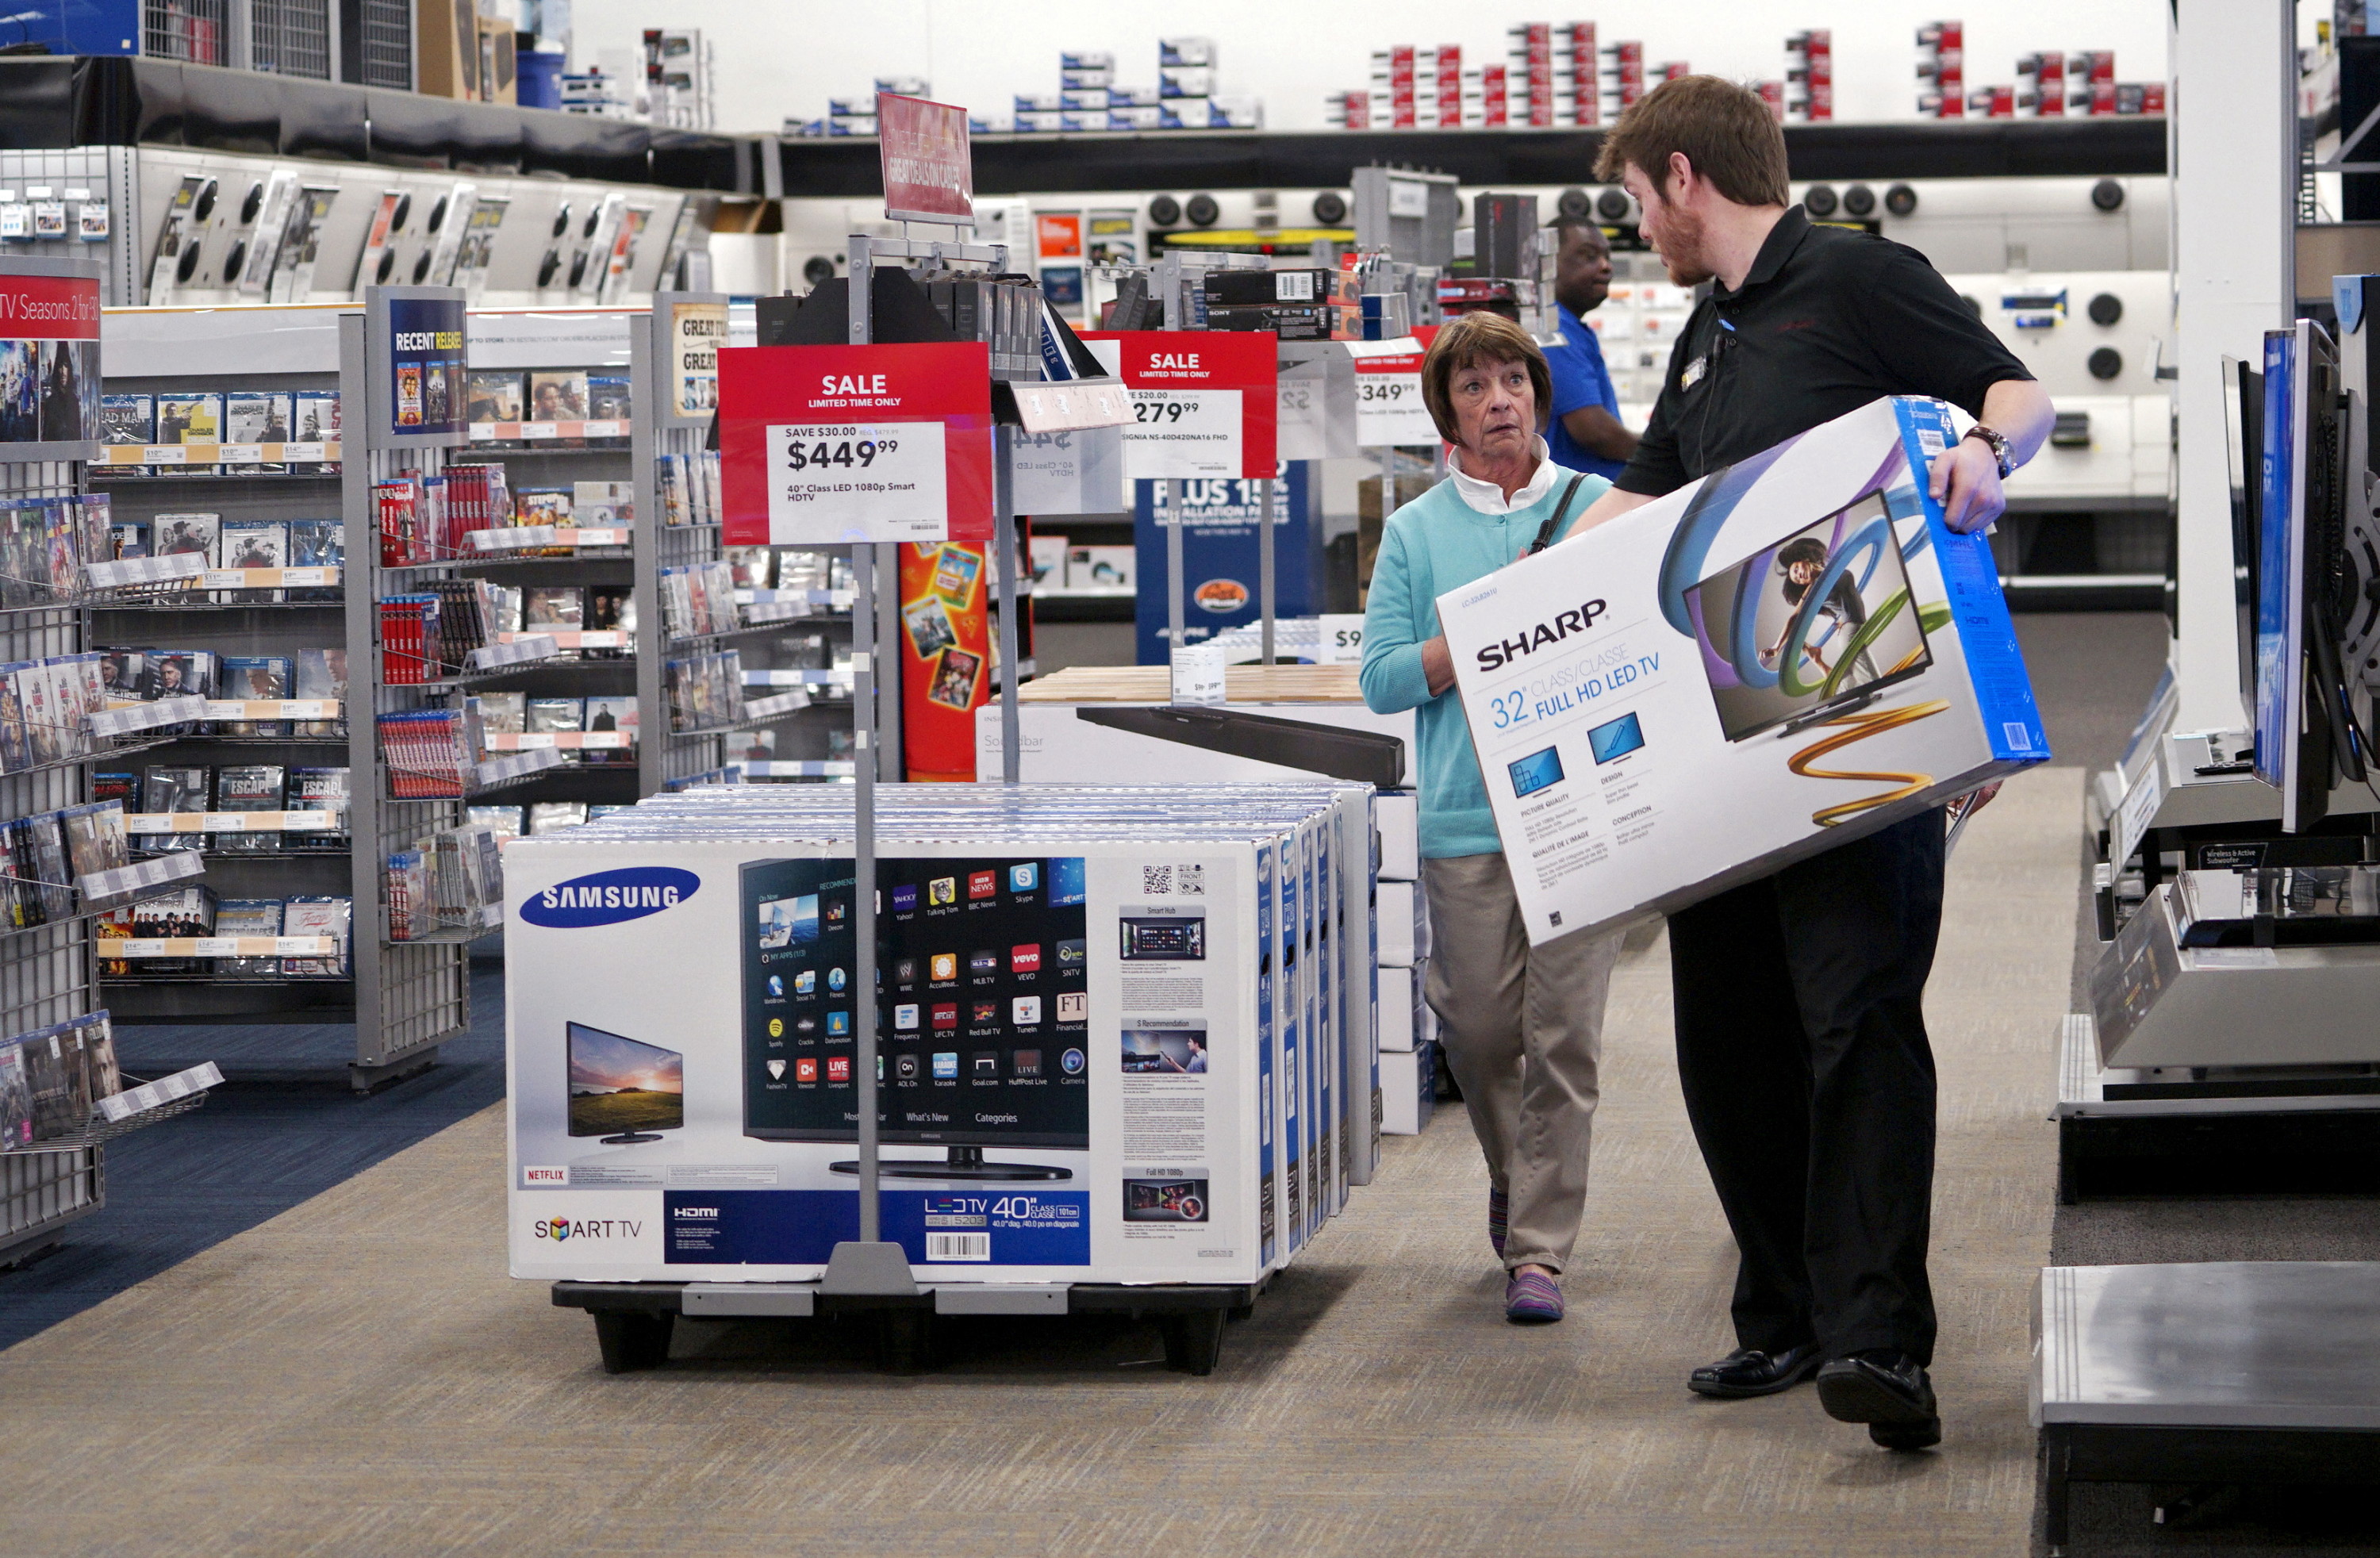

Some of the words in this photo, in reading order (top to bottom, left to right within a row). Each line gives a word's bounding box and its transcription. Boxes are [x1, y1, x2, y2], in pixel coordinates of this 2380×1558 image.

[889, 157, 910, 183] GREAT
[0, 294, 17, 319] TV
[20, 294, 70, 320] Seasons
[72, 295, 77, 320] 2
[79, 294, 89, 320] for
[684, 320, 714, 336] GREAT
[396, 333, 435, 351] RECENT
[1150, 353, 1200, 369] SALE
[821, 374, 887, 396] SALE
[808, 398, 847, 408] LIMITED
[849, 398, 873, 407] TIME
[874, 397, 901, 408] ONLY
[786, 428, 815, 437] SAVE
[818, 427, 856, 437] $30.00
[788, 484, 804, 493] 40"
[807, 483, 831, 493] Class
[834, 483, 852, 492] LED
[854, 482, 885, 493] 1080p
[888, 482, 916, 491] Smart
[788, 493, 815, 502] HDTV
[1476, 599, 1606, 672] SHARP
[1531, 643, 1630, 698] CLASS/CLASSE
[1536, 692, 1574, 720] FULL
[1576, 679, 1603, 704] HD
[1606, 664, 1637, 690] LED
[1638, 652, 1660, 676] TV
[1601, 771, 1623, 785] DESIGN
[1521, 803, 1545, 818] PICTURE
[1545, 793, 1569, 808] QUALITY
[1612, 804, 1652, 827] CONCEPTION
[1557, 838, 1564, 848] DE
[971, 883, 993, 892] NEWS
[543, 885, 679, 908] SAMSUNG
[1015, 895, 1034, 904] Skype
[927, 908, 946, 917] Talking
[1013, 954, 1038, 964] vevo
[1061, 995, 1084, 1012] FT
[894, 1033, 920, 1042] Frequency
[829, 1061, 848, 1071] LIVE
[907, 1112, 931, 1122] What's
[931, 1112, 949, 1122] New
[975, 1112, 1018, 1125] Categories
[528, 1170, 564, 1180] NETFLIX
[674, 1208, 718, 1217] HDMI
[968, 1199, 988, 1213] TV
[618, 1220, 642, 1238] TV
